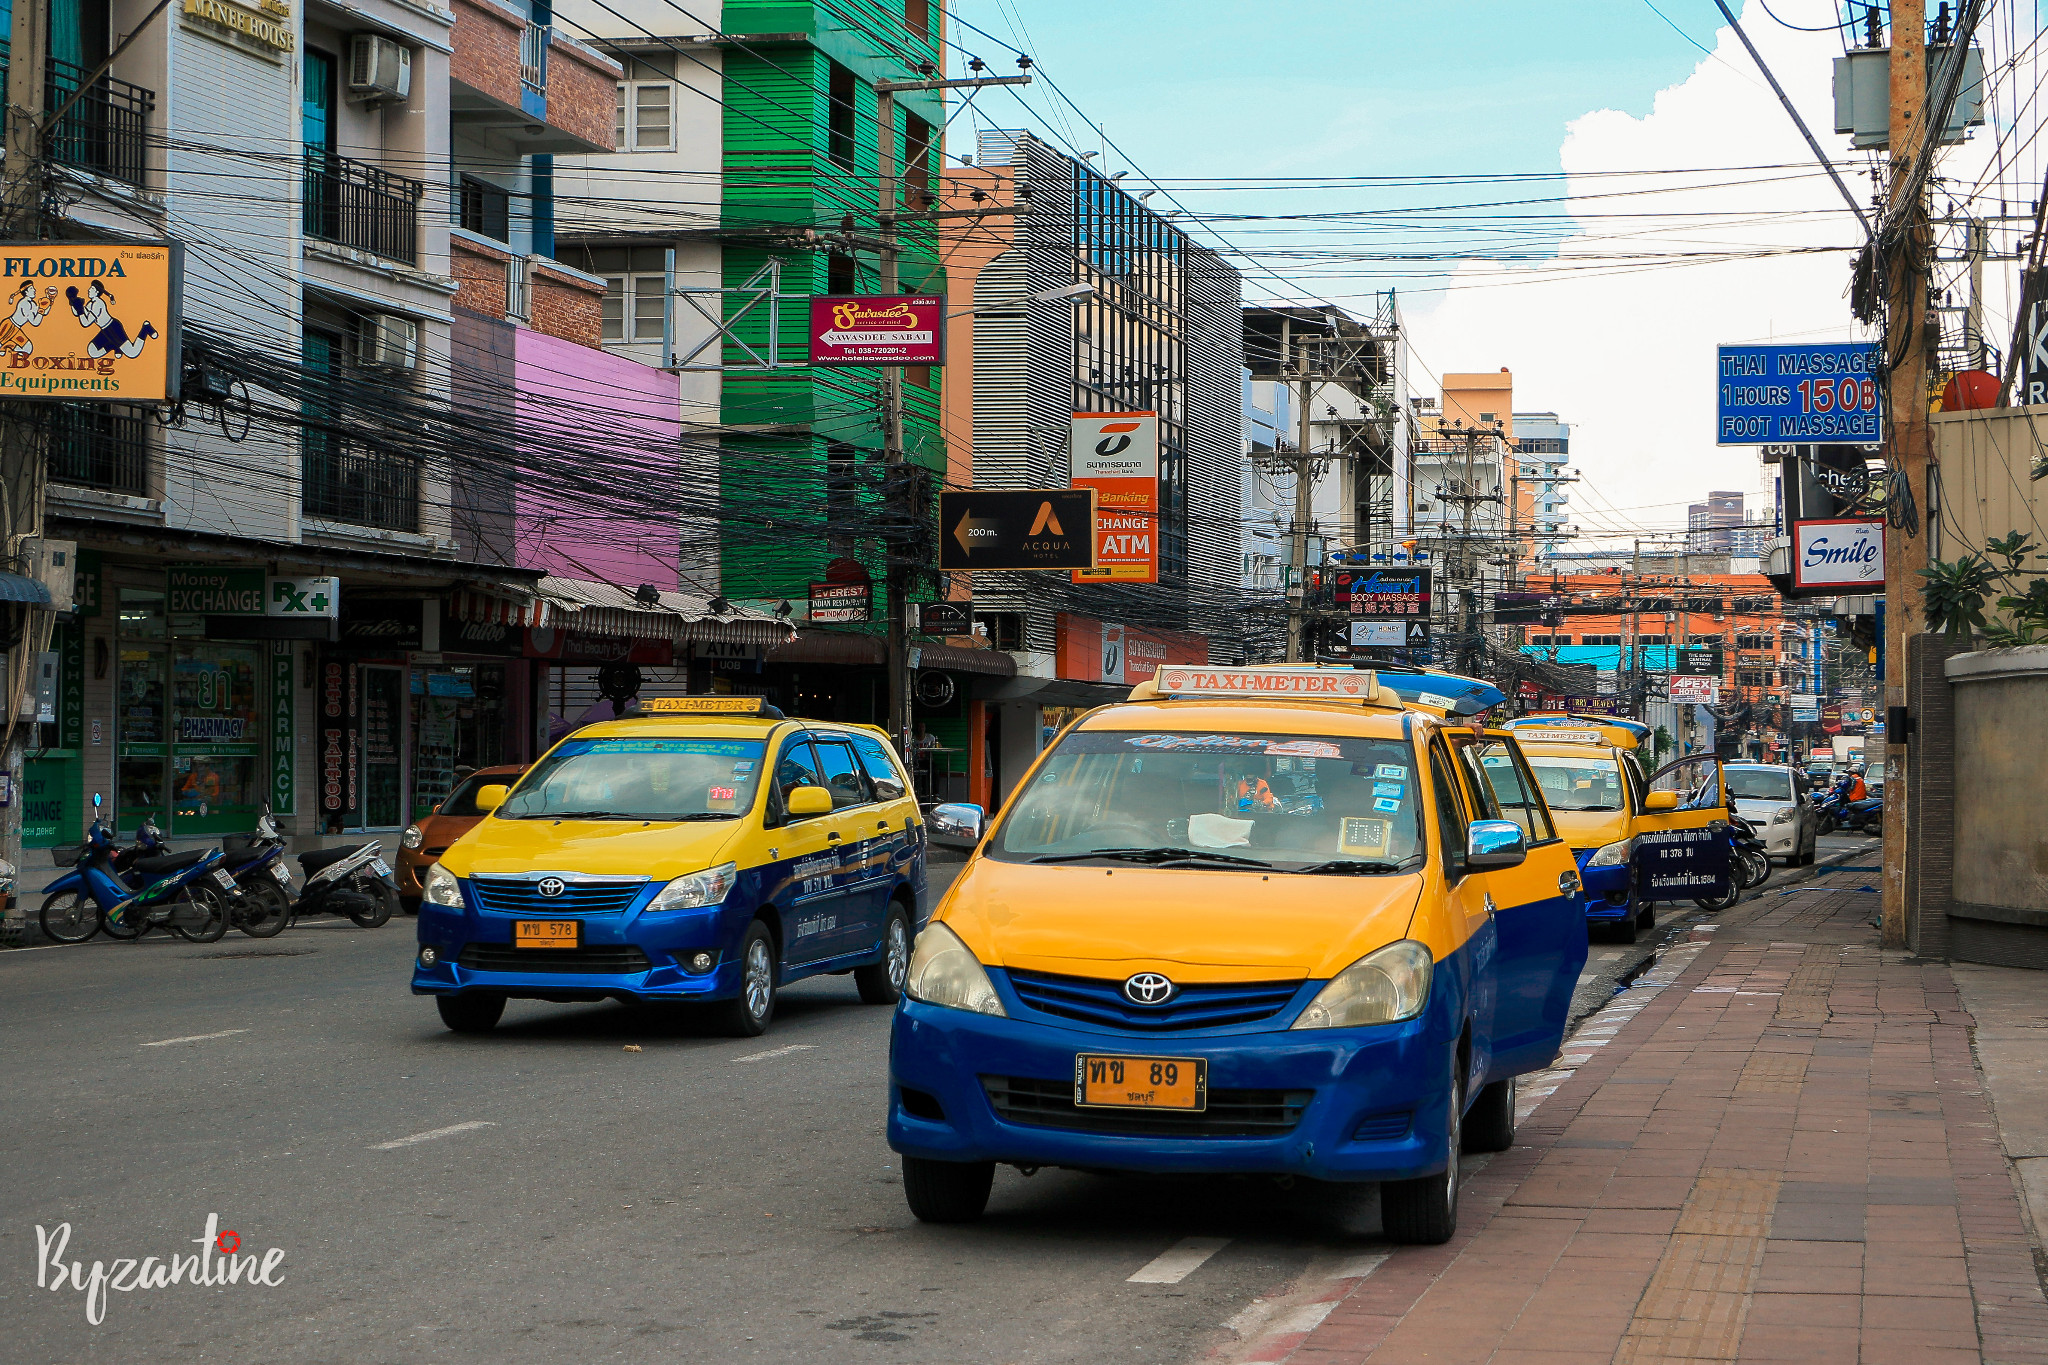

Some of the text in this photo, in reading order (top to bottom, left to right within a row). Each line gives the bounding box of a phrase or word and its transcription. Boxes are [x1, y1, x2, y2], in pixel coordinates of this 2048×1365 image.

[250, 17, 295, 51] HOUSE
[3, 258, 127, 278] FLORIDA
[828, 333, 927, 342] SAWASDEE SABAI
[843, 347, 907, 355] Tel. 038-720201-2
[6, 351, 116, 376] Boxing
[1721, 352, 1878, 377] THAI MASSAGE
[0, 372, 120, 393] Equipments
[1722, 383, 1731, 407] 1
[1734, 385, 1791, 406] HOURS
[1722, 414, 1876, 437] FOOT MASSAGE
[968, 528, 998, 537] 200 m.
[1022, 541, 1071, 551] ACQUA
[1102, 534, 1150, 555] ATM
[1804, 537, 1879, 568] Smile
[171, 572, 229, 590] Money
[815, 585, 864, 598] EVEREST
[1350, 593, 1420, 602] BODY MASSAGE
[171, 589, 262, 612] EXCHANGE
[812, 599, 831, 608] INDIAN
[826, 610, 848, 618] INDIAN
[567, 640, 584, 653] Thai
[584, 640, 611, 656] Beauty
[705, 641, 746, 656] ATM
[719, 661, 741, 670] UOB
[197, 669, 232, 710] ยา
[325, 662, 341, 717] OTTO
[1191, 673, 1339, 694] TAXI-METER
[1671, 676, 1711, 688] APEX
[655, 699, 744, 711] TAXI-METER
[1592, 698, 1616, 708] HEAVEN
[183, 717, 245, 739] PHARMACY
[276, 660, 293, 810] PHARMACY
[325, 729, 341, 810] TATTOO
[709, 787, 735, 800] ว่าง
[1669, 848, 1683, 858] 378
[523, 923, 572, 936] ทข 578
[1089, 1060, 1179, 1087] ทข 89
[1127, 1091, 1155, 1105] ชลบุรี
